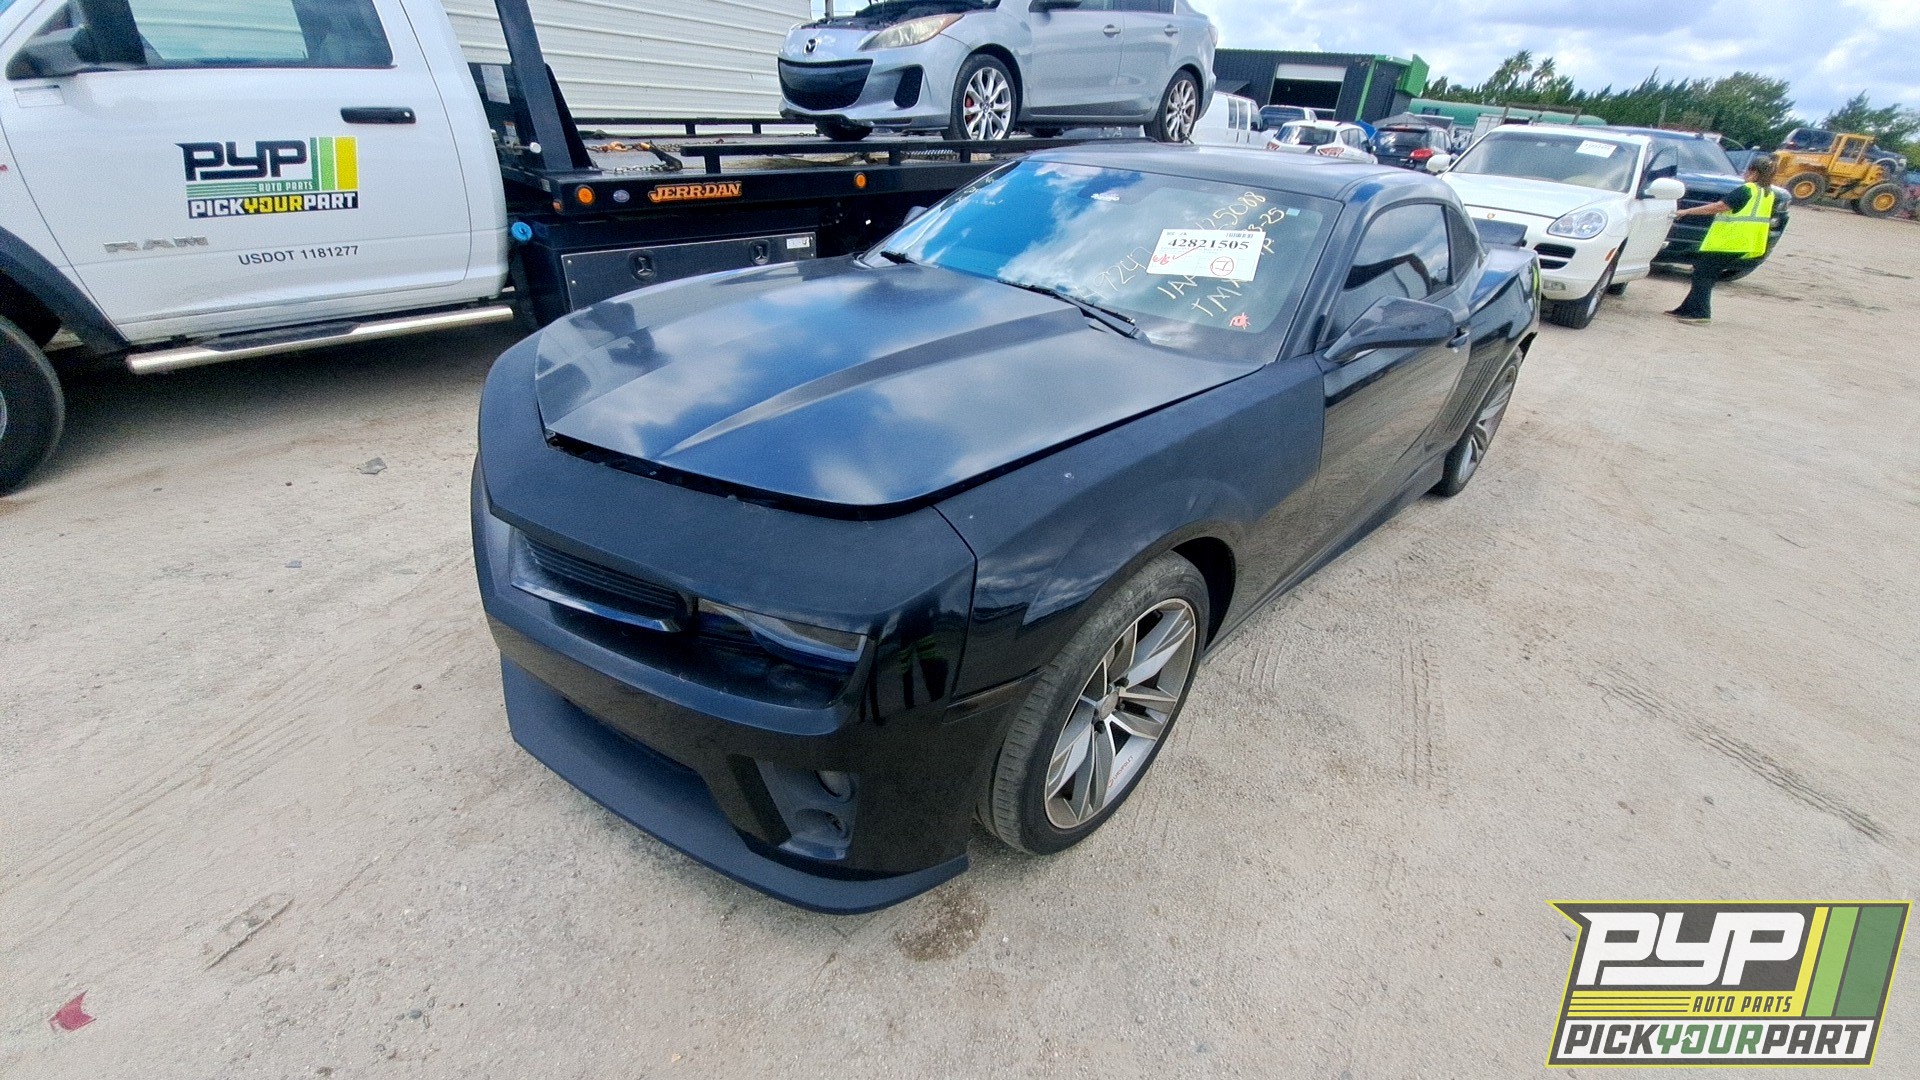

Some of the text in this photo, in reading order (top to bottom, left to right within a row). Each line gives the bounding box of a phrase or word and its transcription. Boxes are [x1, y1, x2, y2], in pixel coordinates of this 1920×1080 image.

[175, 139, 308, 182] PYP
[258, 181, 313, 193] AUTO PARTS
[1168, 238, 1250, 250] 42821505
[238, 245, 359, 266] USDOT 1181277
